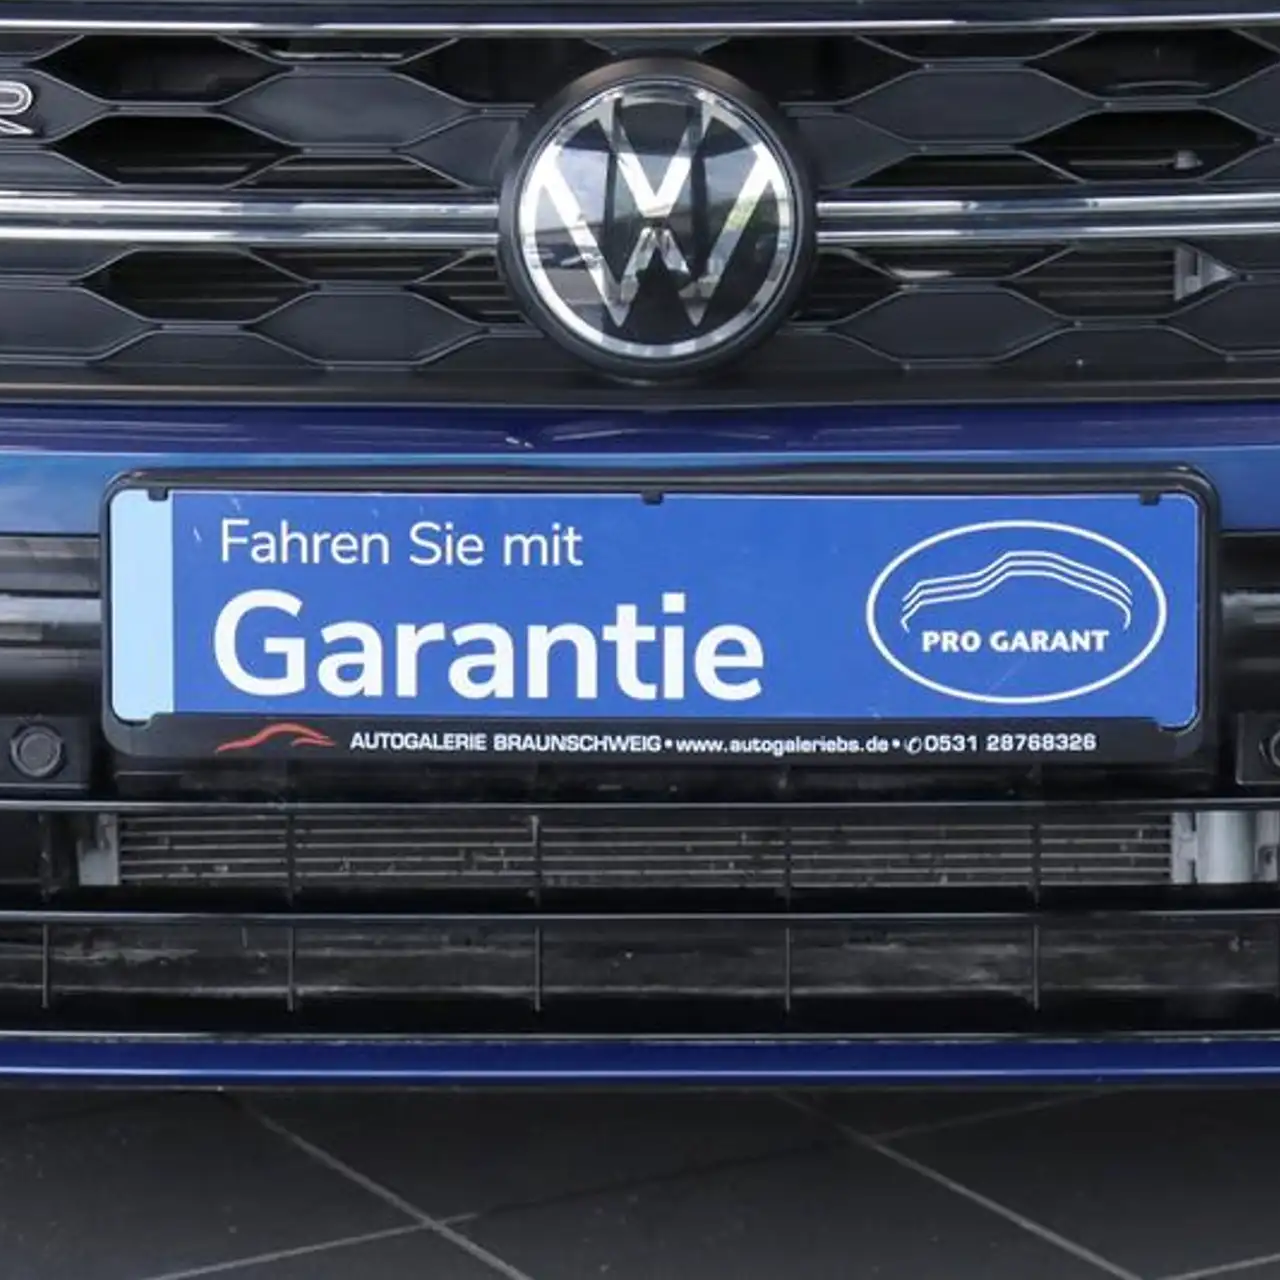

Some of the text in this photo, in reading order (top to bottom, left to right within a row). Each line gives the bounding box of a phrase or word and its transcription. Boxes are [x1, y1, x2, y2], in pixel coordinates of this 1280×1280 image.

[523, 88, 792, 340] VW
[221, 518, 584, 567] Fahren Sie mit
[213, 589, 765, 702] Garantie
[922, 629, 1111, 654] PRO GARANT
[349, 732, 488, 752] AUTOGALERIE
[986, 732, 1098, 753] 28768326
